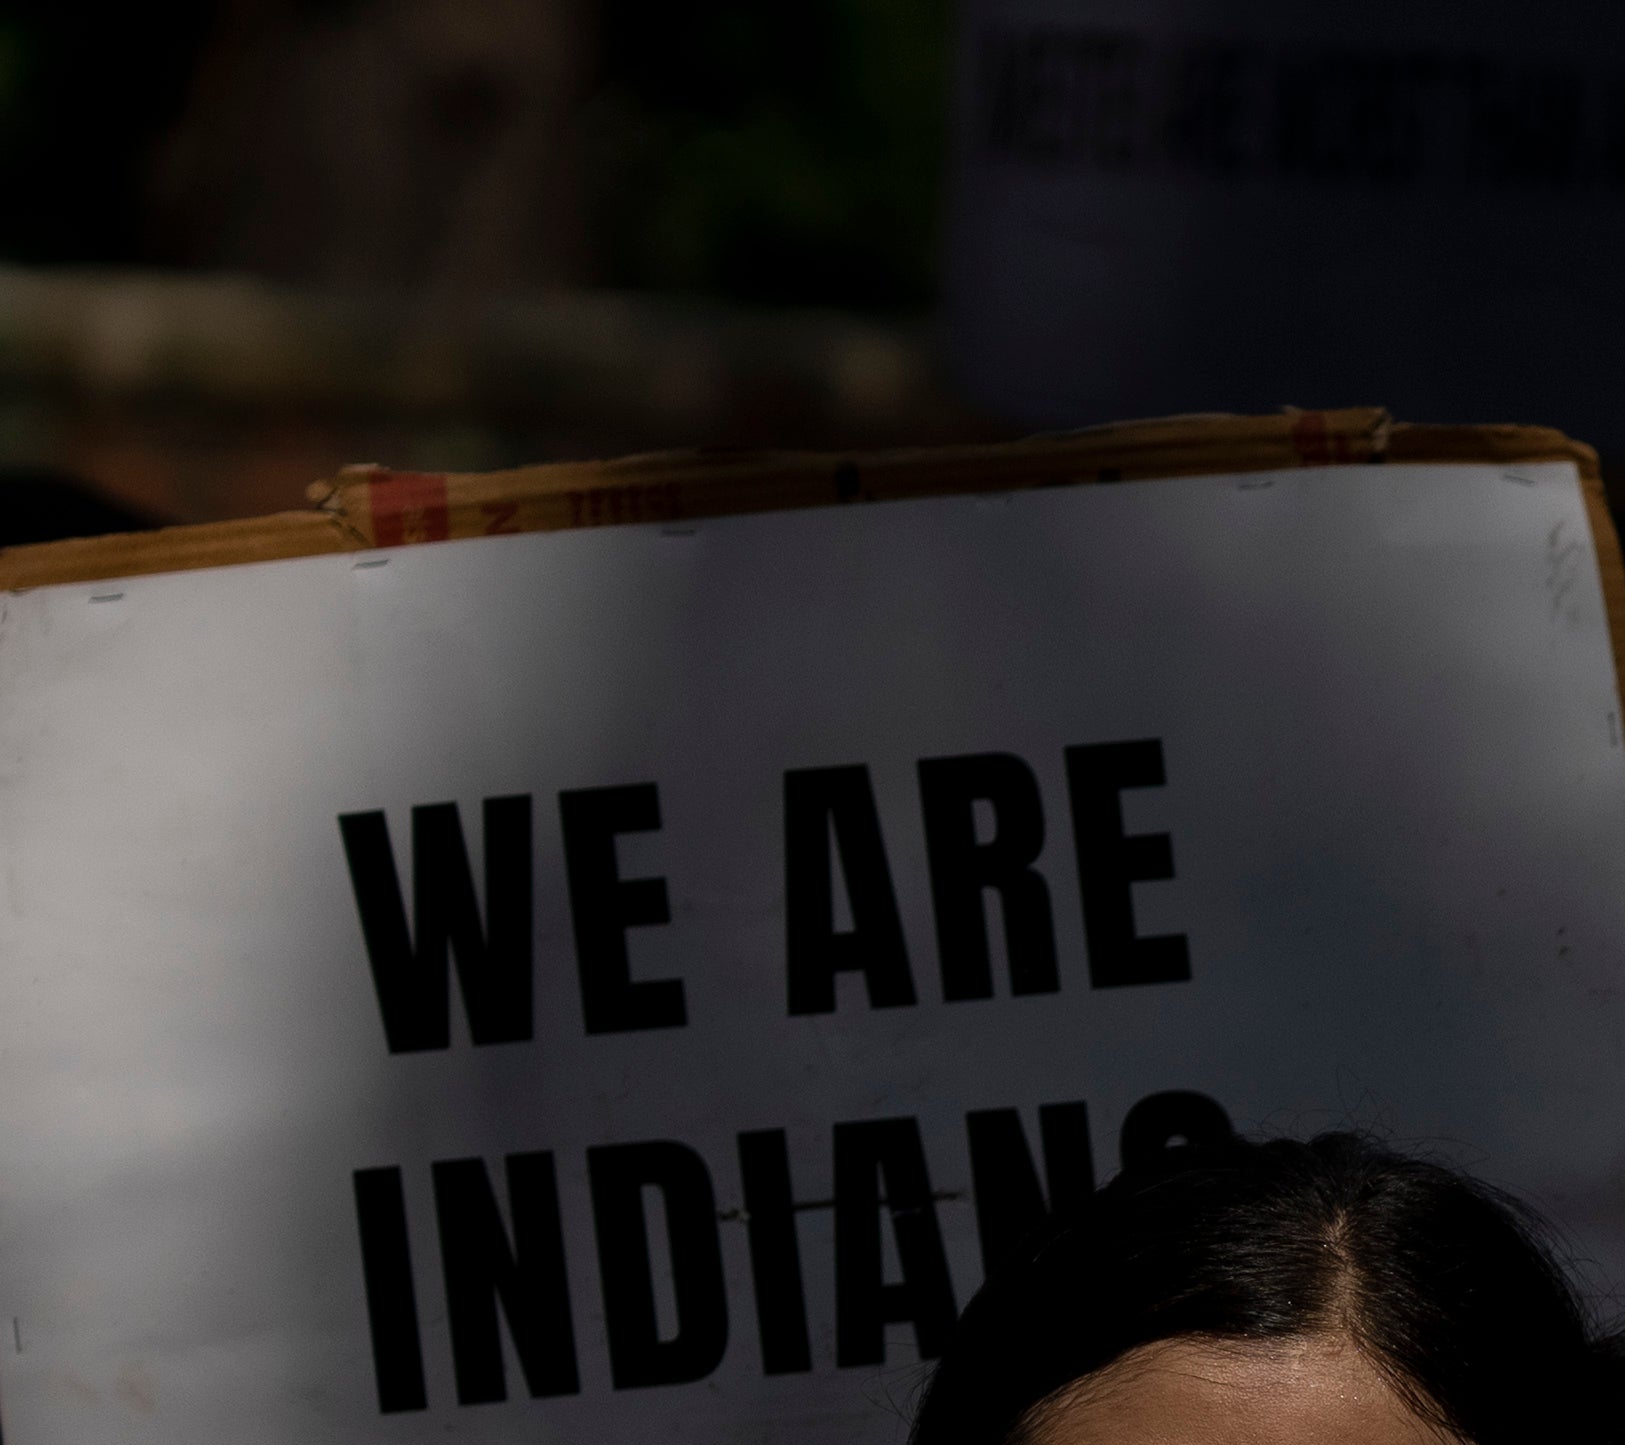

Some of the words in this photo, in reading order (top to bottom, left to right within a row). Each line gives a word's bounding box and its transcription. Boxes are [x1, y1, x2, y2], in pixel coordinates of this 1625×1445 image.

[338, 782, 688, 1055] WE
[783, 738, 1192, 1017] ARE
[352, 1090, 1237, 1415] INDIAN
